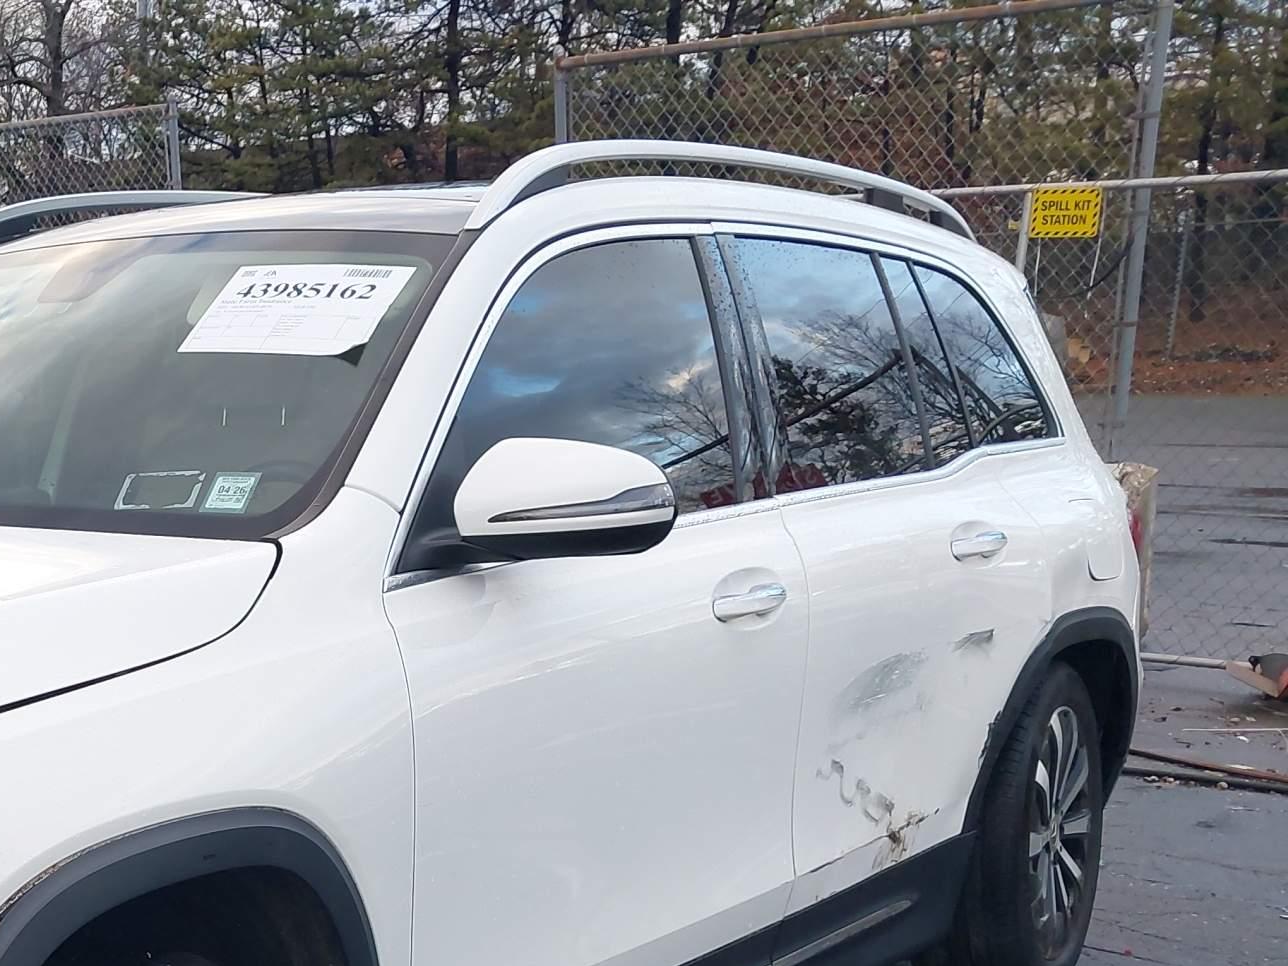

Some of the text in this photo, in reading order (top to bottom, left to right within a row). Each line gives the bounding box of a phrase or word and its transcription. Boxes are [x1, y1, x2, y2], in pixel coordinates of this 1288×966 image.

[1040, 199, 1092, 211] SPILL KIT
[1041, 214, 1087, 225] STATION
[236, 282, 377, 299] 43985162
